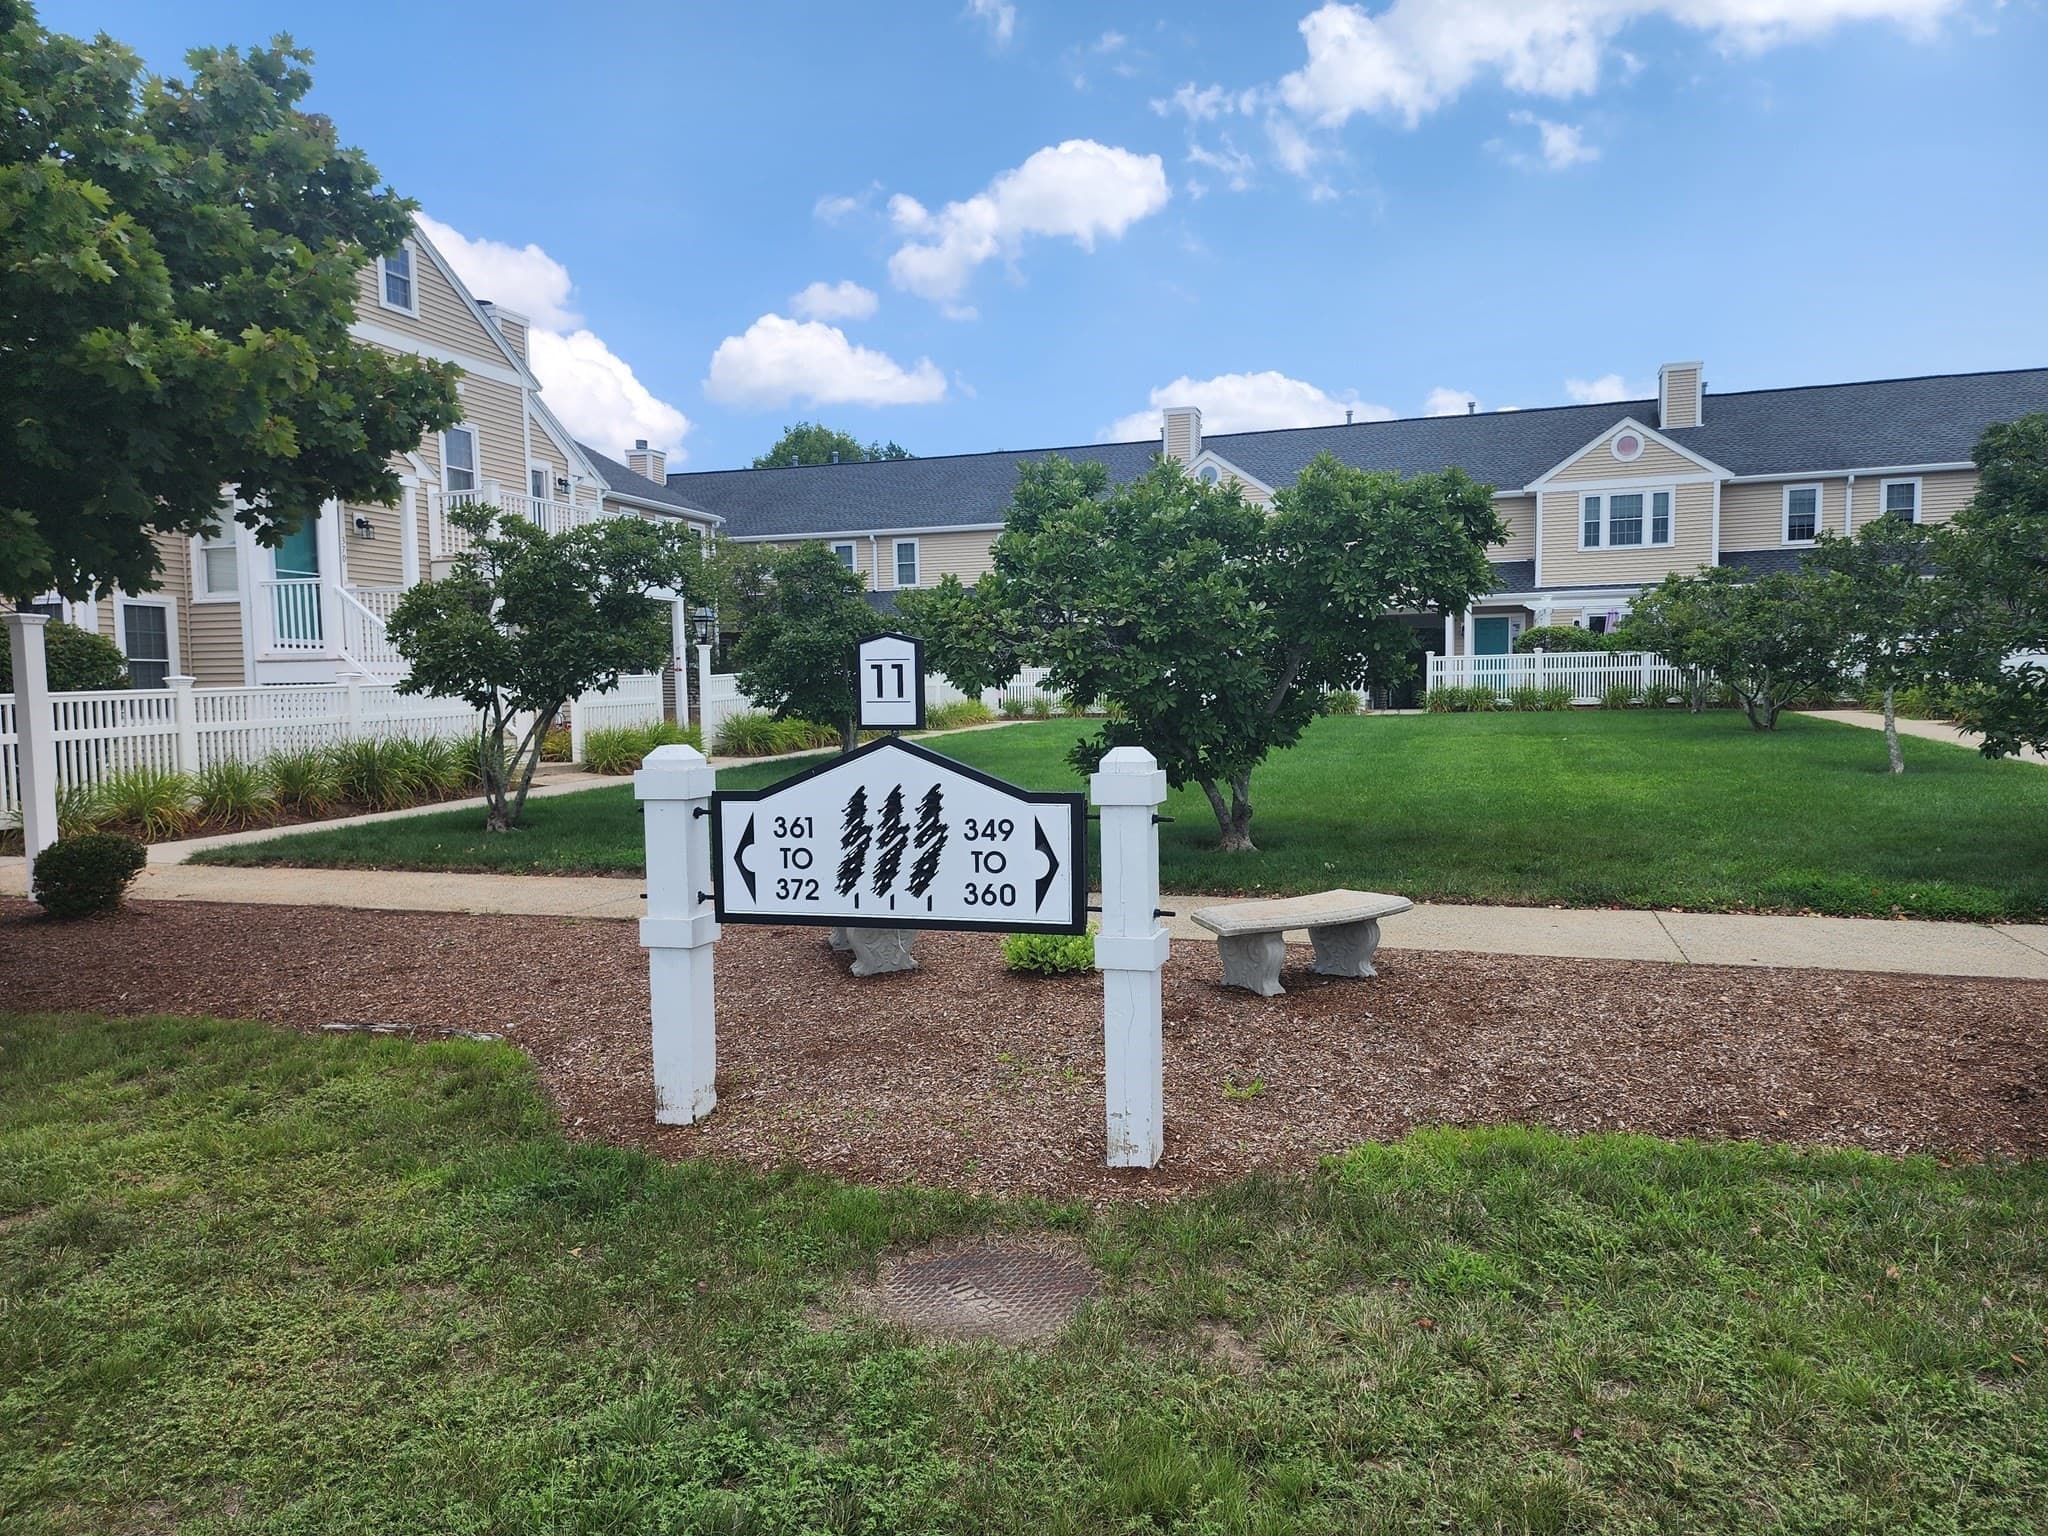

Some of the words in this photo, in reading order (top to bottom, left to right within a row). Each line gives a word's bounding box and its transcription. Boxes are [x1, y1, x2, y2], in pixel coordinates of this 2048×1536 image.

[871, 664, 904, 699] 11
[773, 816, 813, 839] 361
[963, 818, 1015, 842] 349
[779, 847, 814, 870] TO
[970, 850, 1007, 874] TO
[775, 877, 820, 901] 372
[963, 882, 1016, 907] 360
